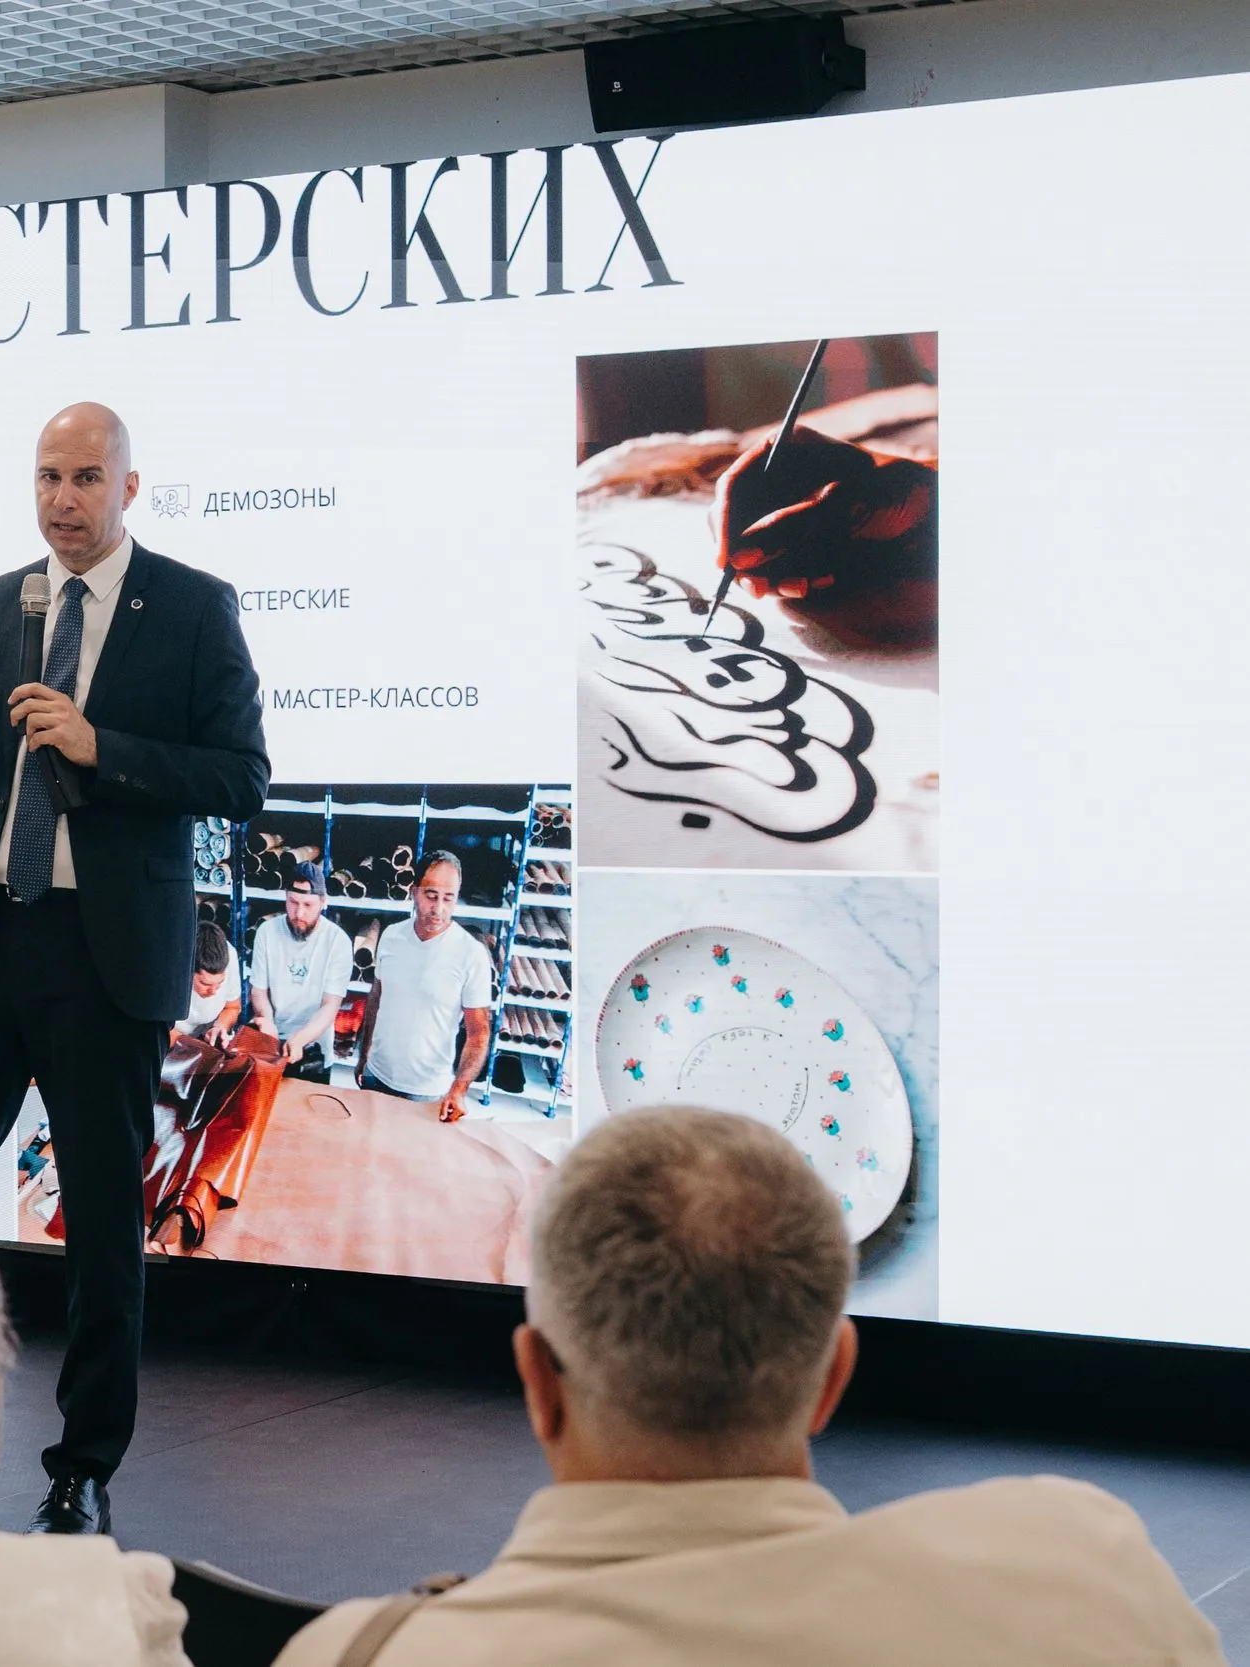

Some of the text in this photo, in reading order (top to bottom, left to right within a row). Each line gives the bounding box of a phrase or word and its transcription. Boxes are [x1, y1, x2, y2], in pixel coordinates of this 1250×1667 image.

[203, 486, 336, 518] ДЕМОЗОНЫ
[240, 588, 351, 611] СТЕРСКИЕ
[273, 686, 479, 710] МАСТЕР-КЛАССОВ
